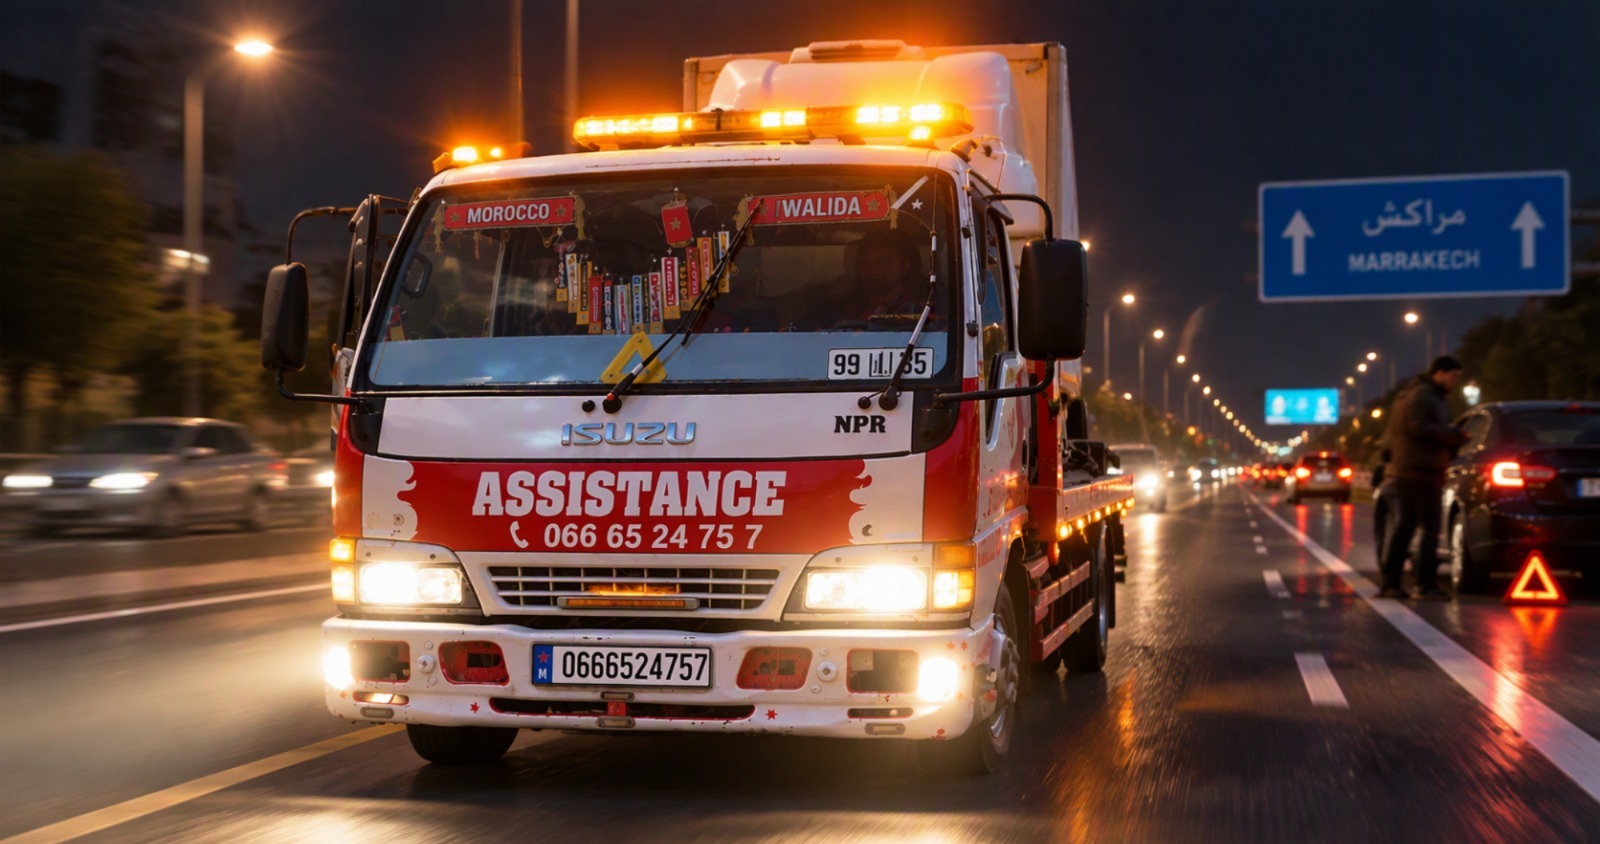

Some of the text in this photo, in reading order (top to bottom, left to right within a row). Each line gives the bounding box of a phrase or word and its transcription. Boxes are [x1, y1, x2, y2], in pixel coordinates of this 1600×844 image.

[467, 203, 550, 224] MOROCCO
[1362, 199, 1466, 237] مراكش
[1348, 249, 1480, 273] MARRAKECH
[833, 353, 860, 375] 99
[561, 422, 697, 446] ISUZU
[834, 415, 886, 433] NPR
[472, 470, 787, 517] ASSISTANCE
[544, 523, 764, 549] 066 65 24 75 7
[538, 651, 708, 681] M 0666524757
